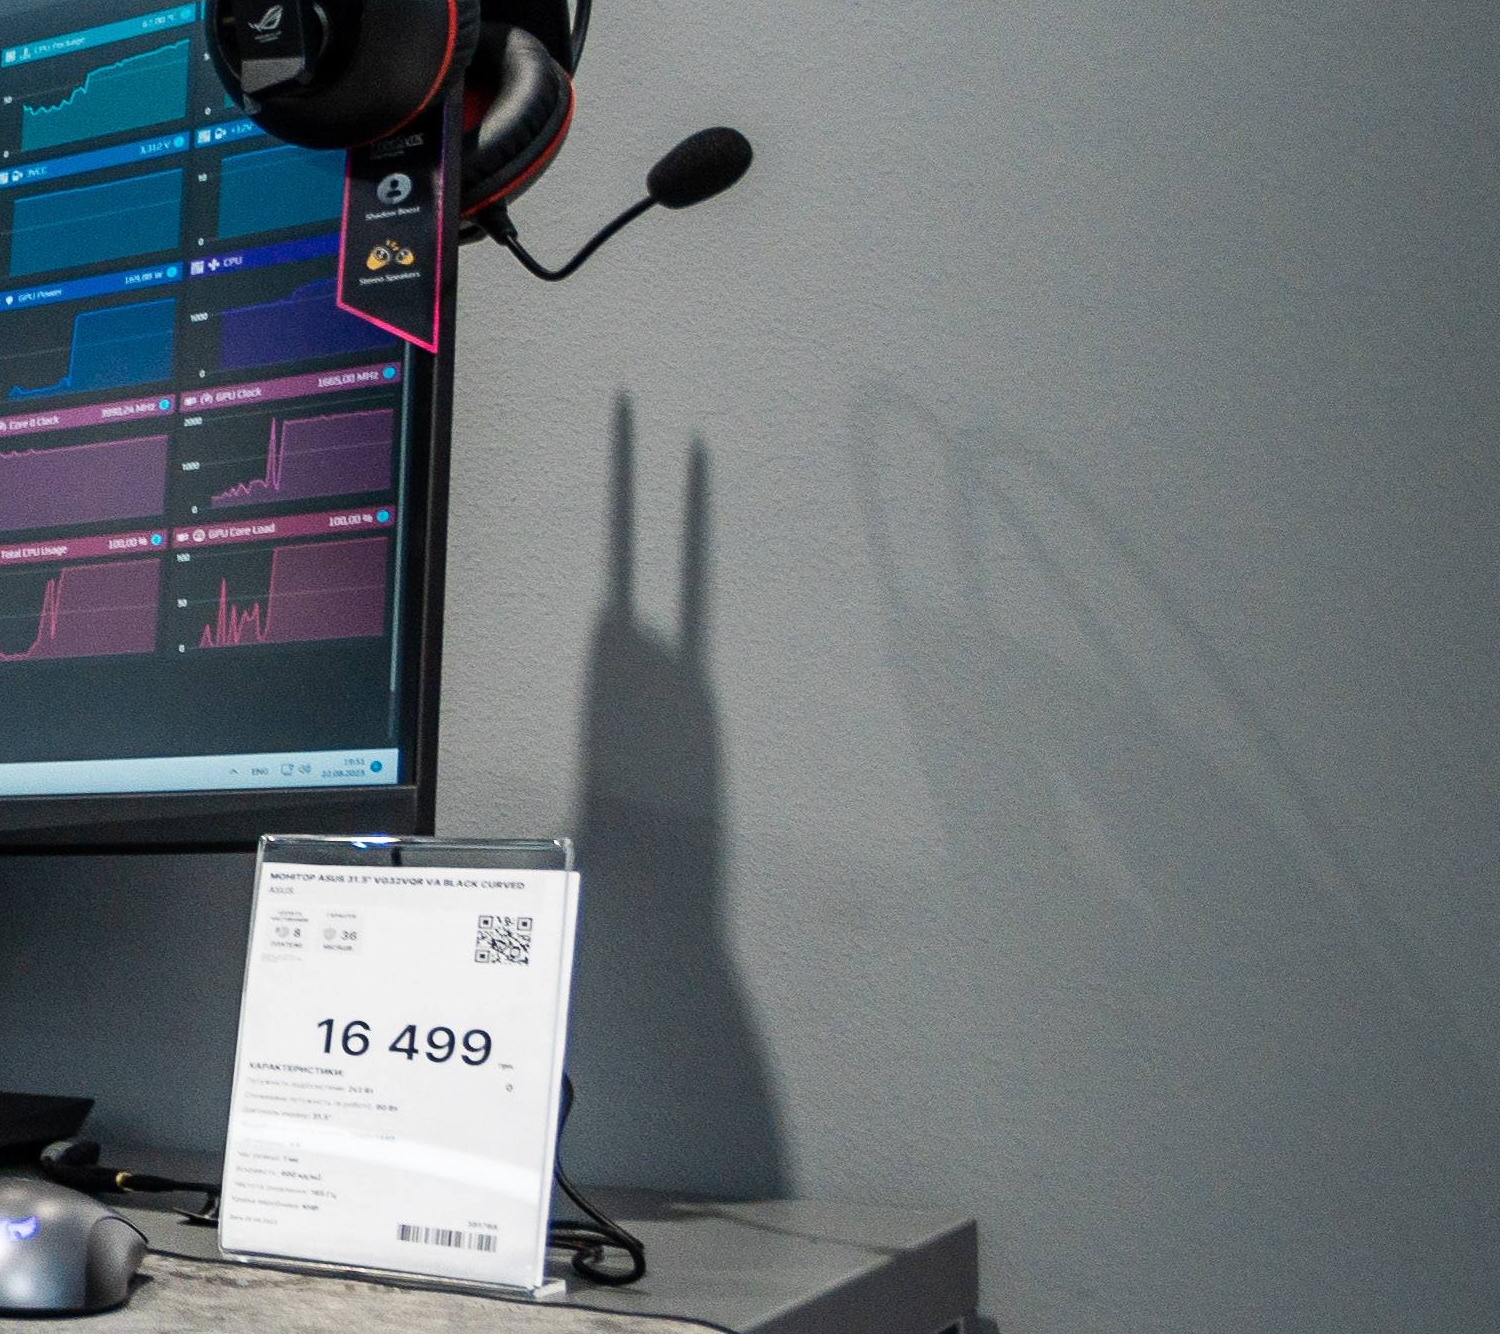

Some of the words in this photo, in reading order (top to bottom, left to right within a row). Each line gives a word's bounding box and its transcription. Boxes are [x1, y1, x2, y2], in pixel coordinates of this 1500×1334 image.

[365, 210, 397, 221] Shadow
[216, 390, 235, 401] GPU
[238, 386, 262, 399] Clock
[209, 527, 228, 539] GPU
[230, 526, 252, 537] Core
[253, 521, 275, 535] Load
[1, 548, 20, 560] Total
[40, 545, 68, 559] Usage
[252, 768, 268, 776] ENG
[318, 875, 346, 884] ASUS
[426, 878, 441, 886] VA
[444, 879, 478, 889] BLACK
[481, 881, 525, 890] CURVED
[269, 886, 294, 895] ASUS
[293, 929, 301, 938] 8
[341, 930, 357, 941] 36
[317, 1018, 371, 1056] 16
[388, 1024, 492, 1066] 499
